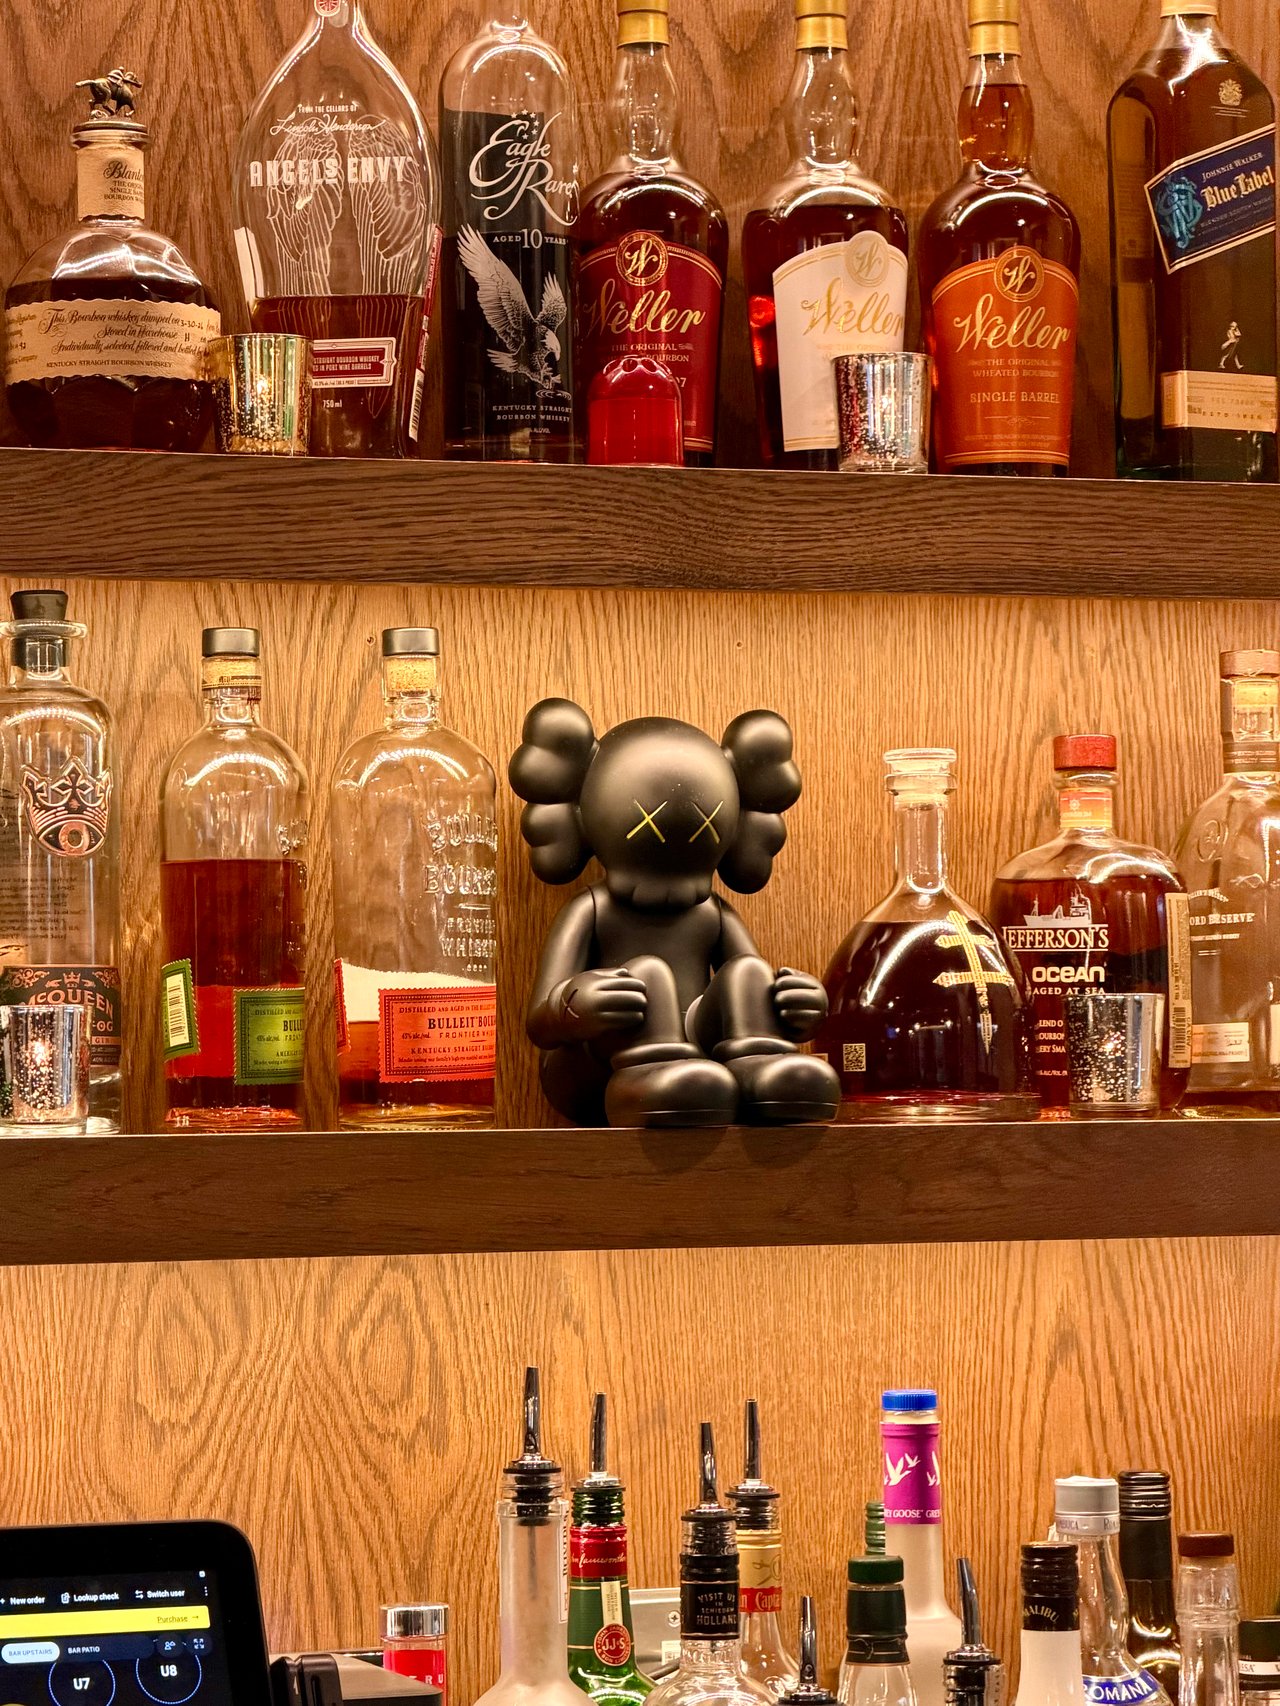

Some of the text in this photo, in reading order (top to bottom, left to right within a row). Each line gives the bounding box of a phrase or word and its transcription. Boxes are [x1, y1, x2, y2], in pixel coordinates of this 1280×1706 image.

[315, 104, 325, 113] THE
[326, 103, 349, 112] CELLARS
[469, 111, 562, 200] Eagle
[347, 156, 407, 184] ENVY
[1201, 151, 1266, 183] JOHNNIE WALKER
[483, 157, 578, 226] Rare
[1200, 165, 1275, 212] Blue Label
[493, 228, 567, 249] AGED 10 YEARS
[583, 278, 706, 337] Weller
[68, 309, 106, 325] Bourbon
[140, 311, 172, 327] dumped
[953, 293, 1071, 353] Weller
[630, 343, 677, 351] ORIGINAL
[111, 359, 144, 367] BOURBON
[359, 355, 380, 363] WHISKEY
[987, 358, 1049, 367] THE ORIGINAL
[973, 369, 1020, 377] WHEATED
[970, 391, 1061, 404] SINGLE BARREL
[323, 399, 334, 408] 750
[492, 404, 537, 412] KENTUCKY
[1208, 912, 1251, 925] RESERVE
[1001, 926, 1109, 949] JEFFERSON'S
[1033, 986, 1106, 995] AGED AT SEA
[399, 1006, 436, 1014] DISTILLED
[427, 1016, 475, 1030] BULLEIT
[439, 1030, 480, 1039] FRONTIER
[411, 1046, 451, 1055] KENTUCKY
[892, 1508, 921, 1519] GOOSE
[73, 1591, 119, 1602] Lookup check
[146, 1589, 185, 1598] Switch user
[697, 1591, 724, 1604] VISIT
[10, 1595, 46, 1605] New order
[156, 1615, 188, 1624] Purchase
[8, 1648, 53, 1657] BAR UPSTAIRS
[67, 1645, 100, 1654] BAR PATIO
[160, 1664, 178, 1678] U8
[72, 1676, 90, 1691] U7
